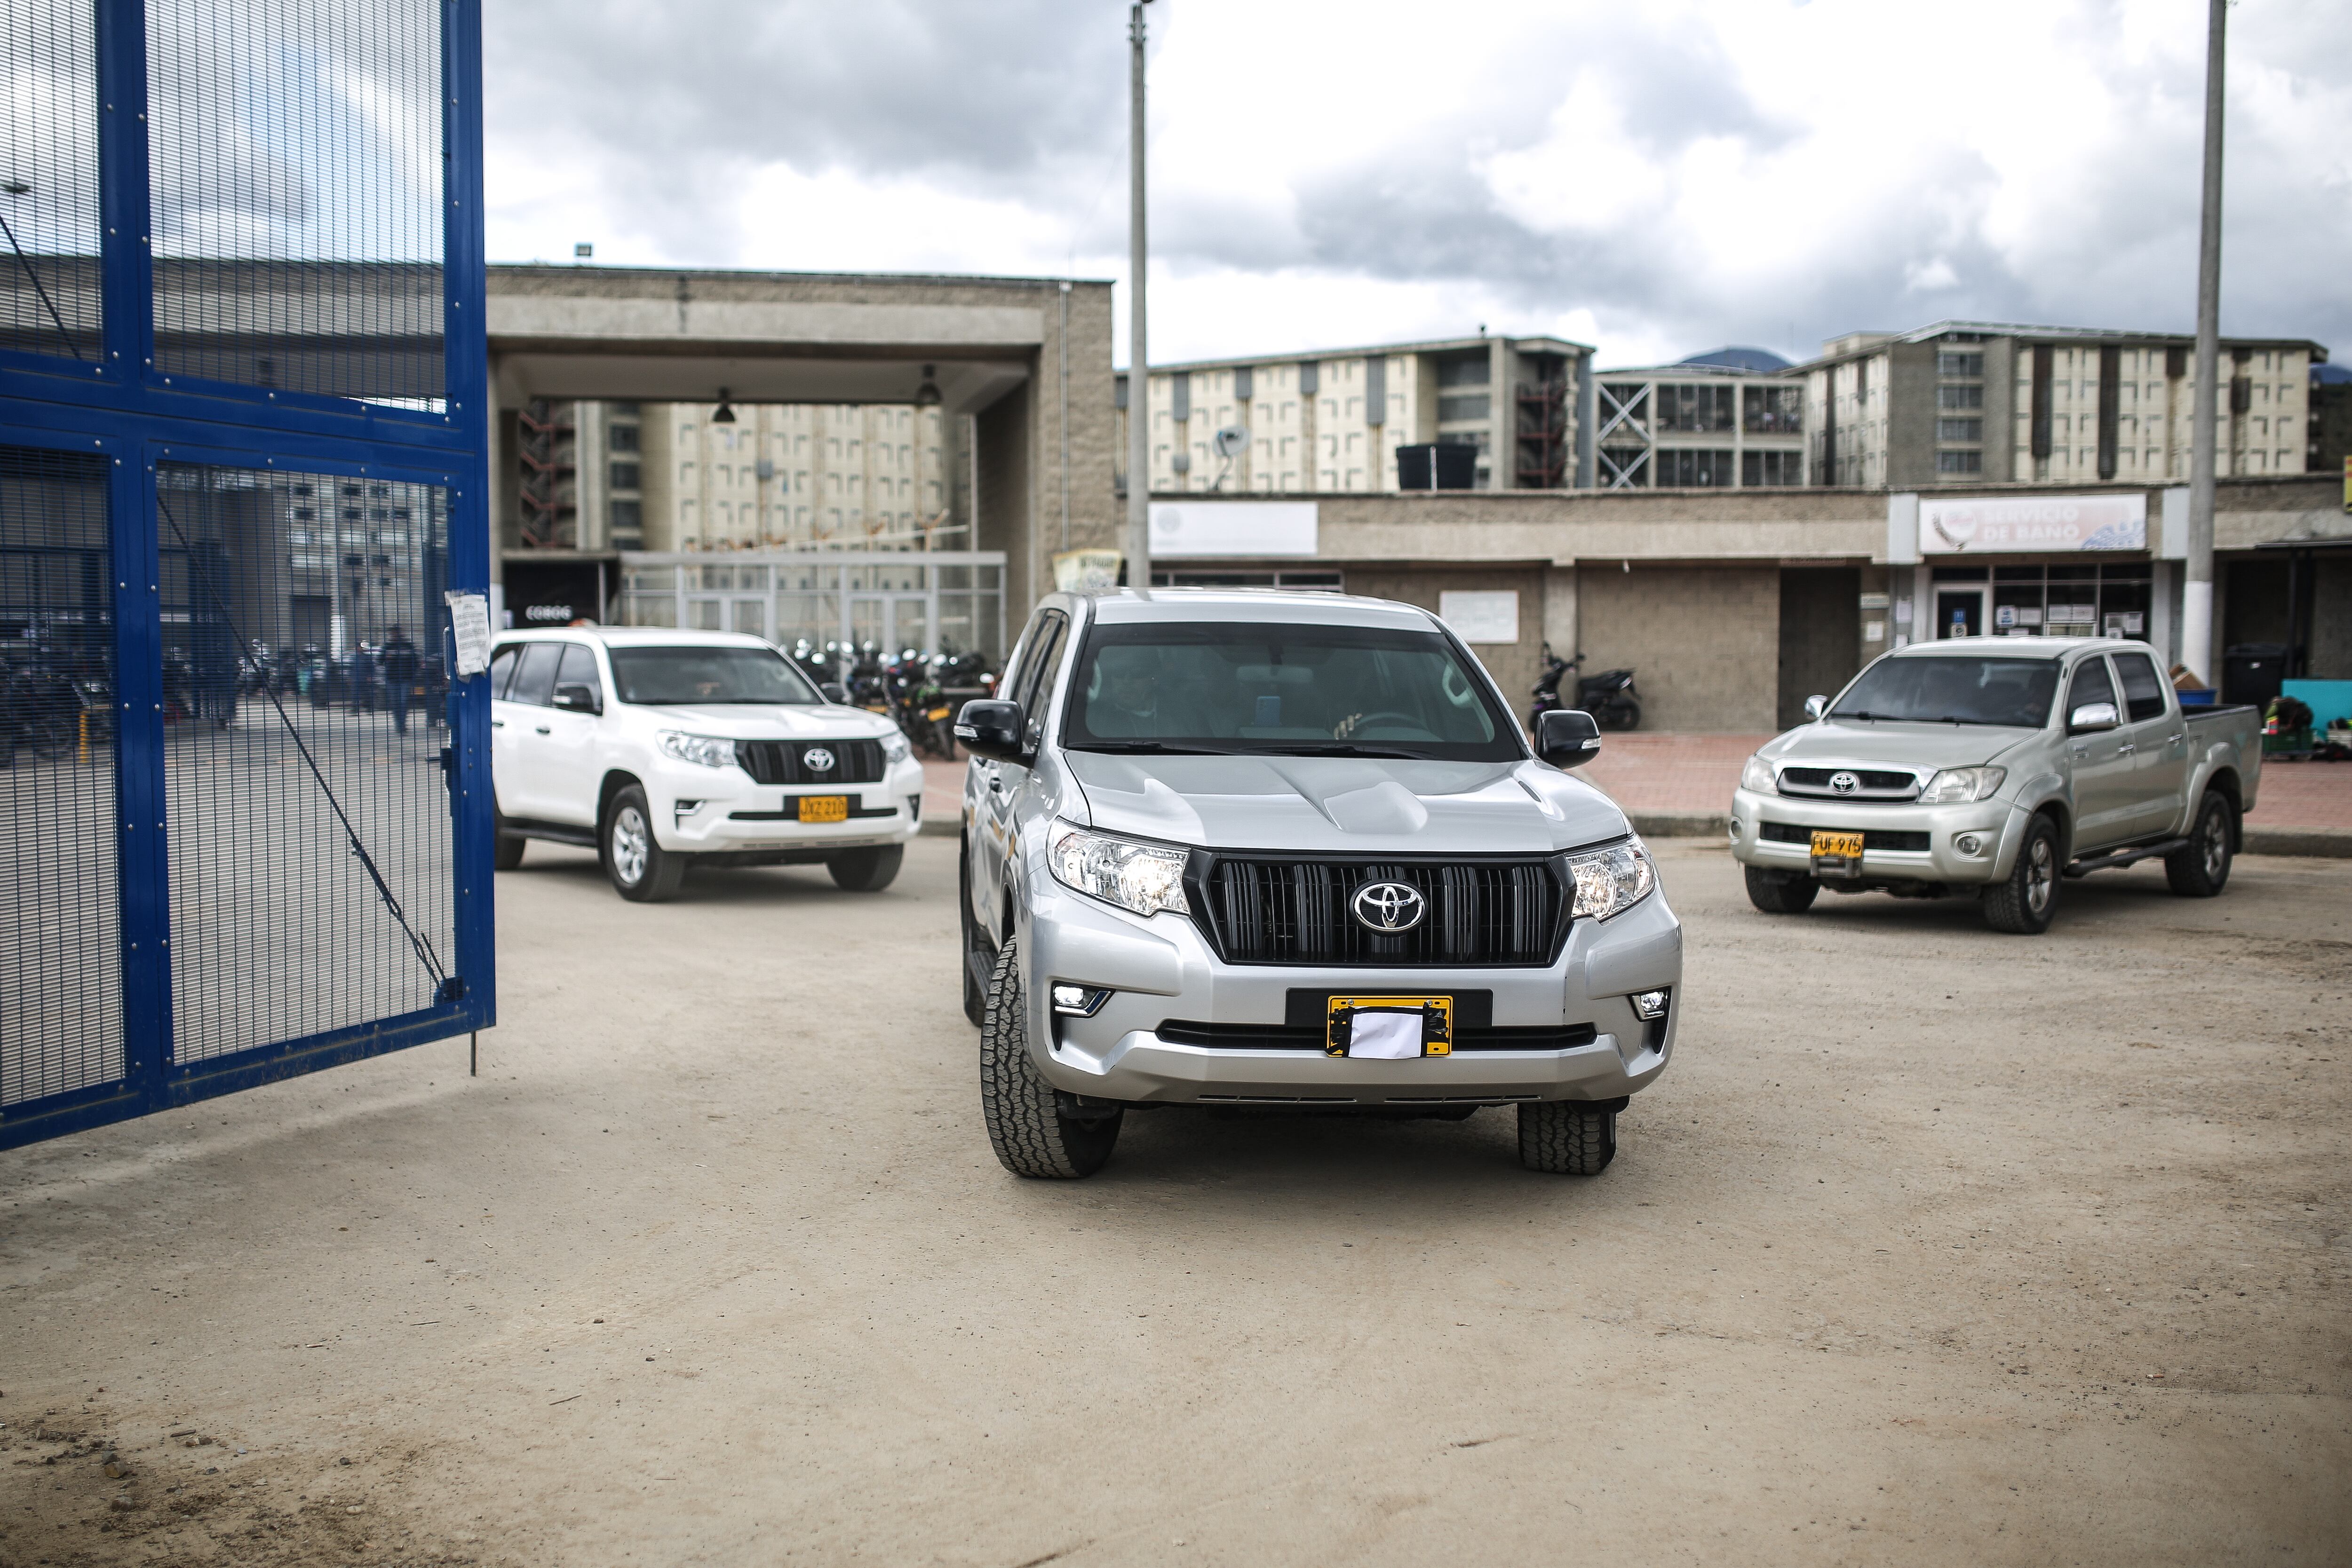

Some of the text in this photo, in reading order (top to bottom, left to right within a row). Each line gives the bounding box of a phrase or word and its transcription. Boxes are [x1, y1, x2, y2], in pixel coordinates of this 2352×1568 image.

[1984, 506, 2079, 523] SERVICIO
[1984, 524, 2009, 540] DE
[1813, 834, 1836, 851] FUF
